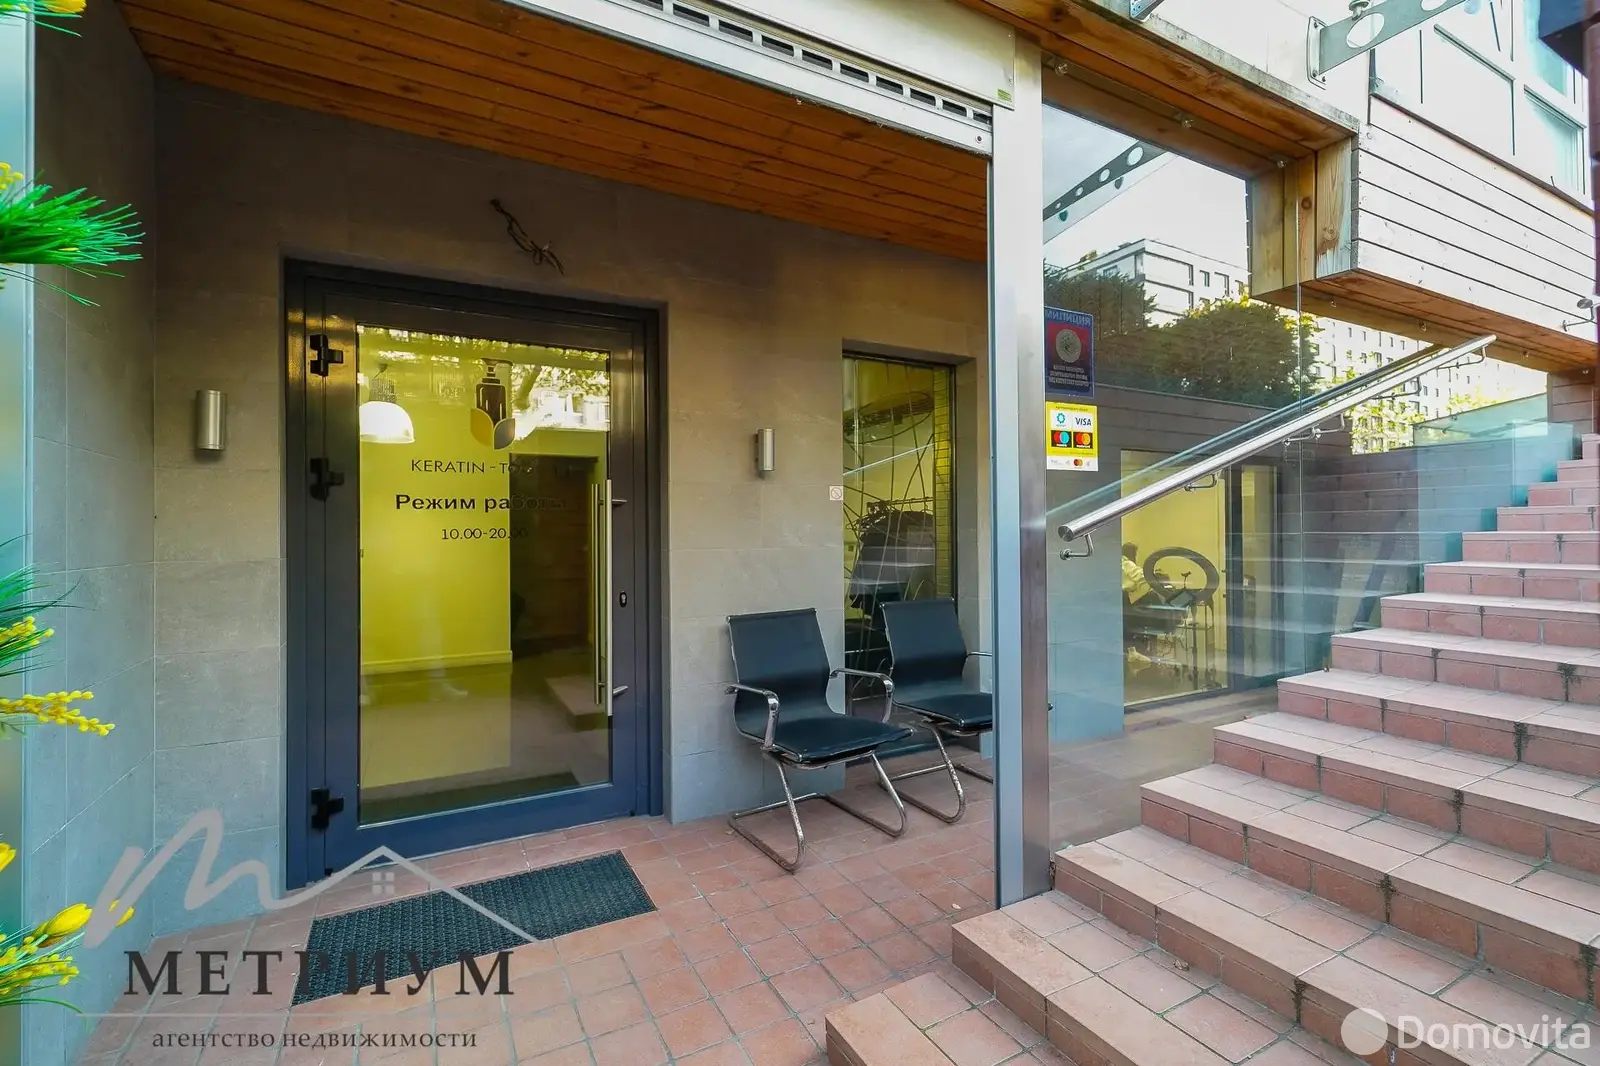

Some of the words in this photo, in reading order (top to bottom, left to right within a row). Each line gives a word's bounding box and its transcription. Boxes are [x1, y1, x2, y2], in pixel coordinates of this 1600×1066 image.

[1045, 310, 1091, 327] МИЛИЦИЯ
[1075, 417, 1092, 426] VISA
[411, 459, 485, 473] KERATIN
[395, 494, 476, 510] Режим
[484, 493, 567, 513] работы
[441, 527, 528, 540] 10.00-20.00
